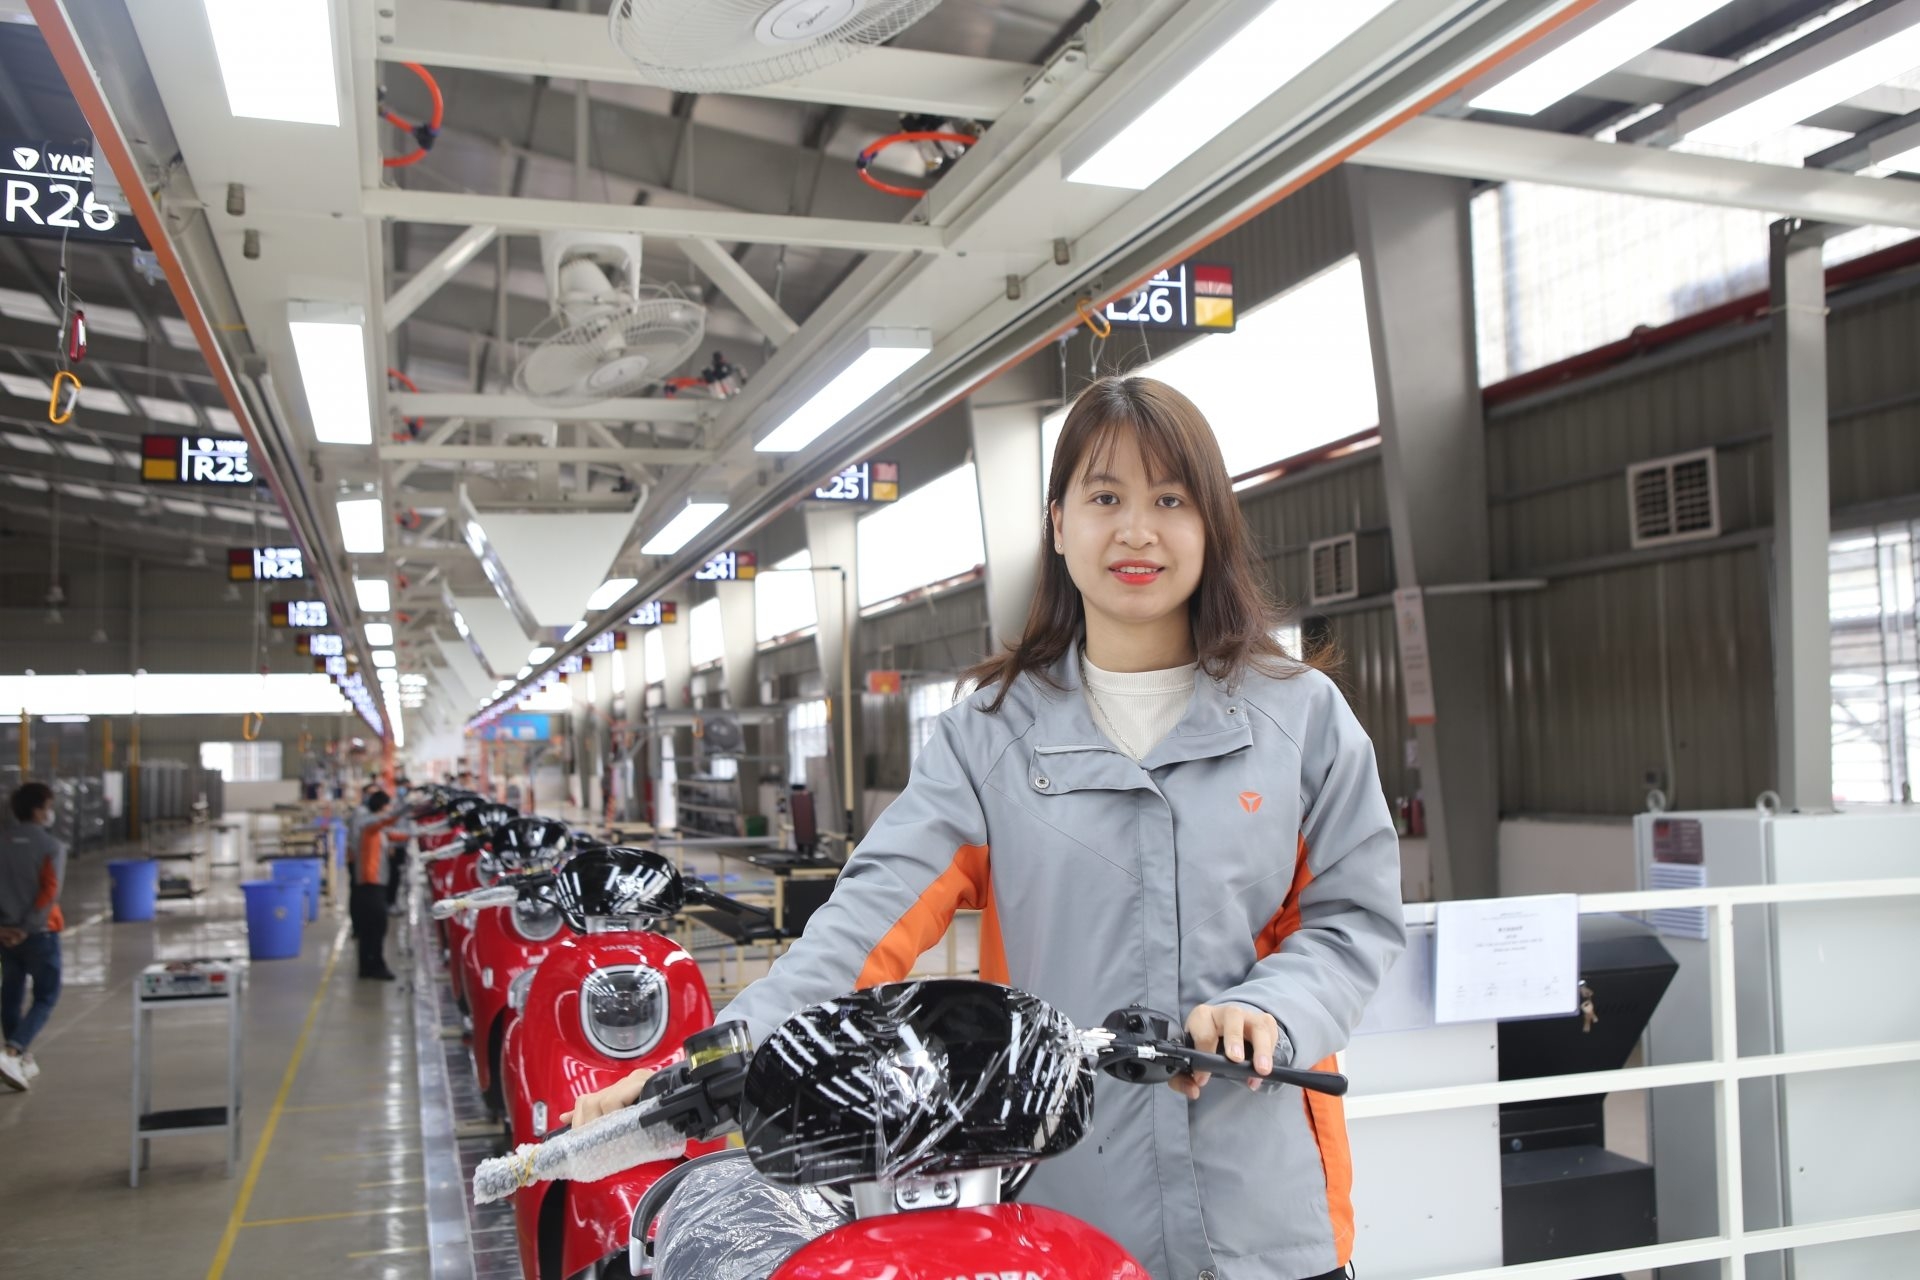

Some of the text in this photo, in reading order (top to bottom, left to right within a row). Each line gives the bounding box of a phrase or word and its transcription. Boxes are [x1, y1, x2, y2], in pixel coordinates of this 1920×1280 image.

[48, 153, 95, 174] YADE
[5, 180, 116, 231] R26
[194, 456, 253, 482] R25
